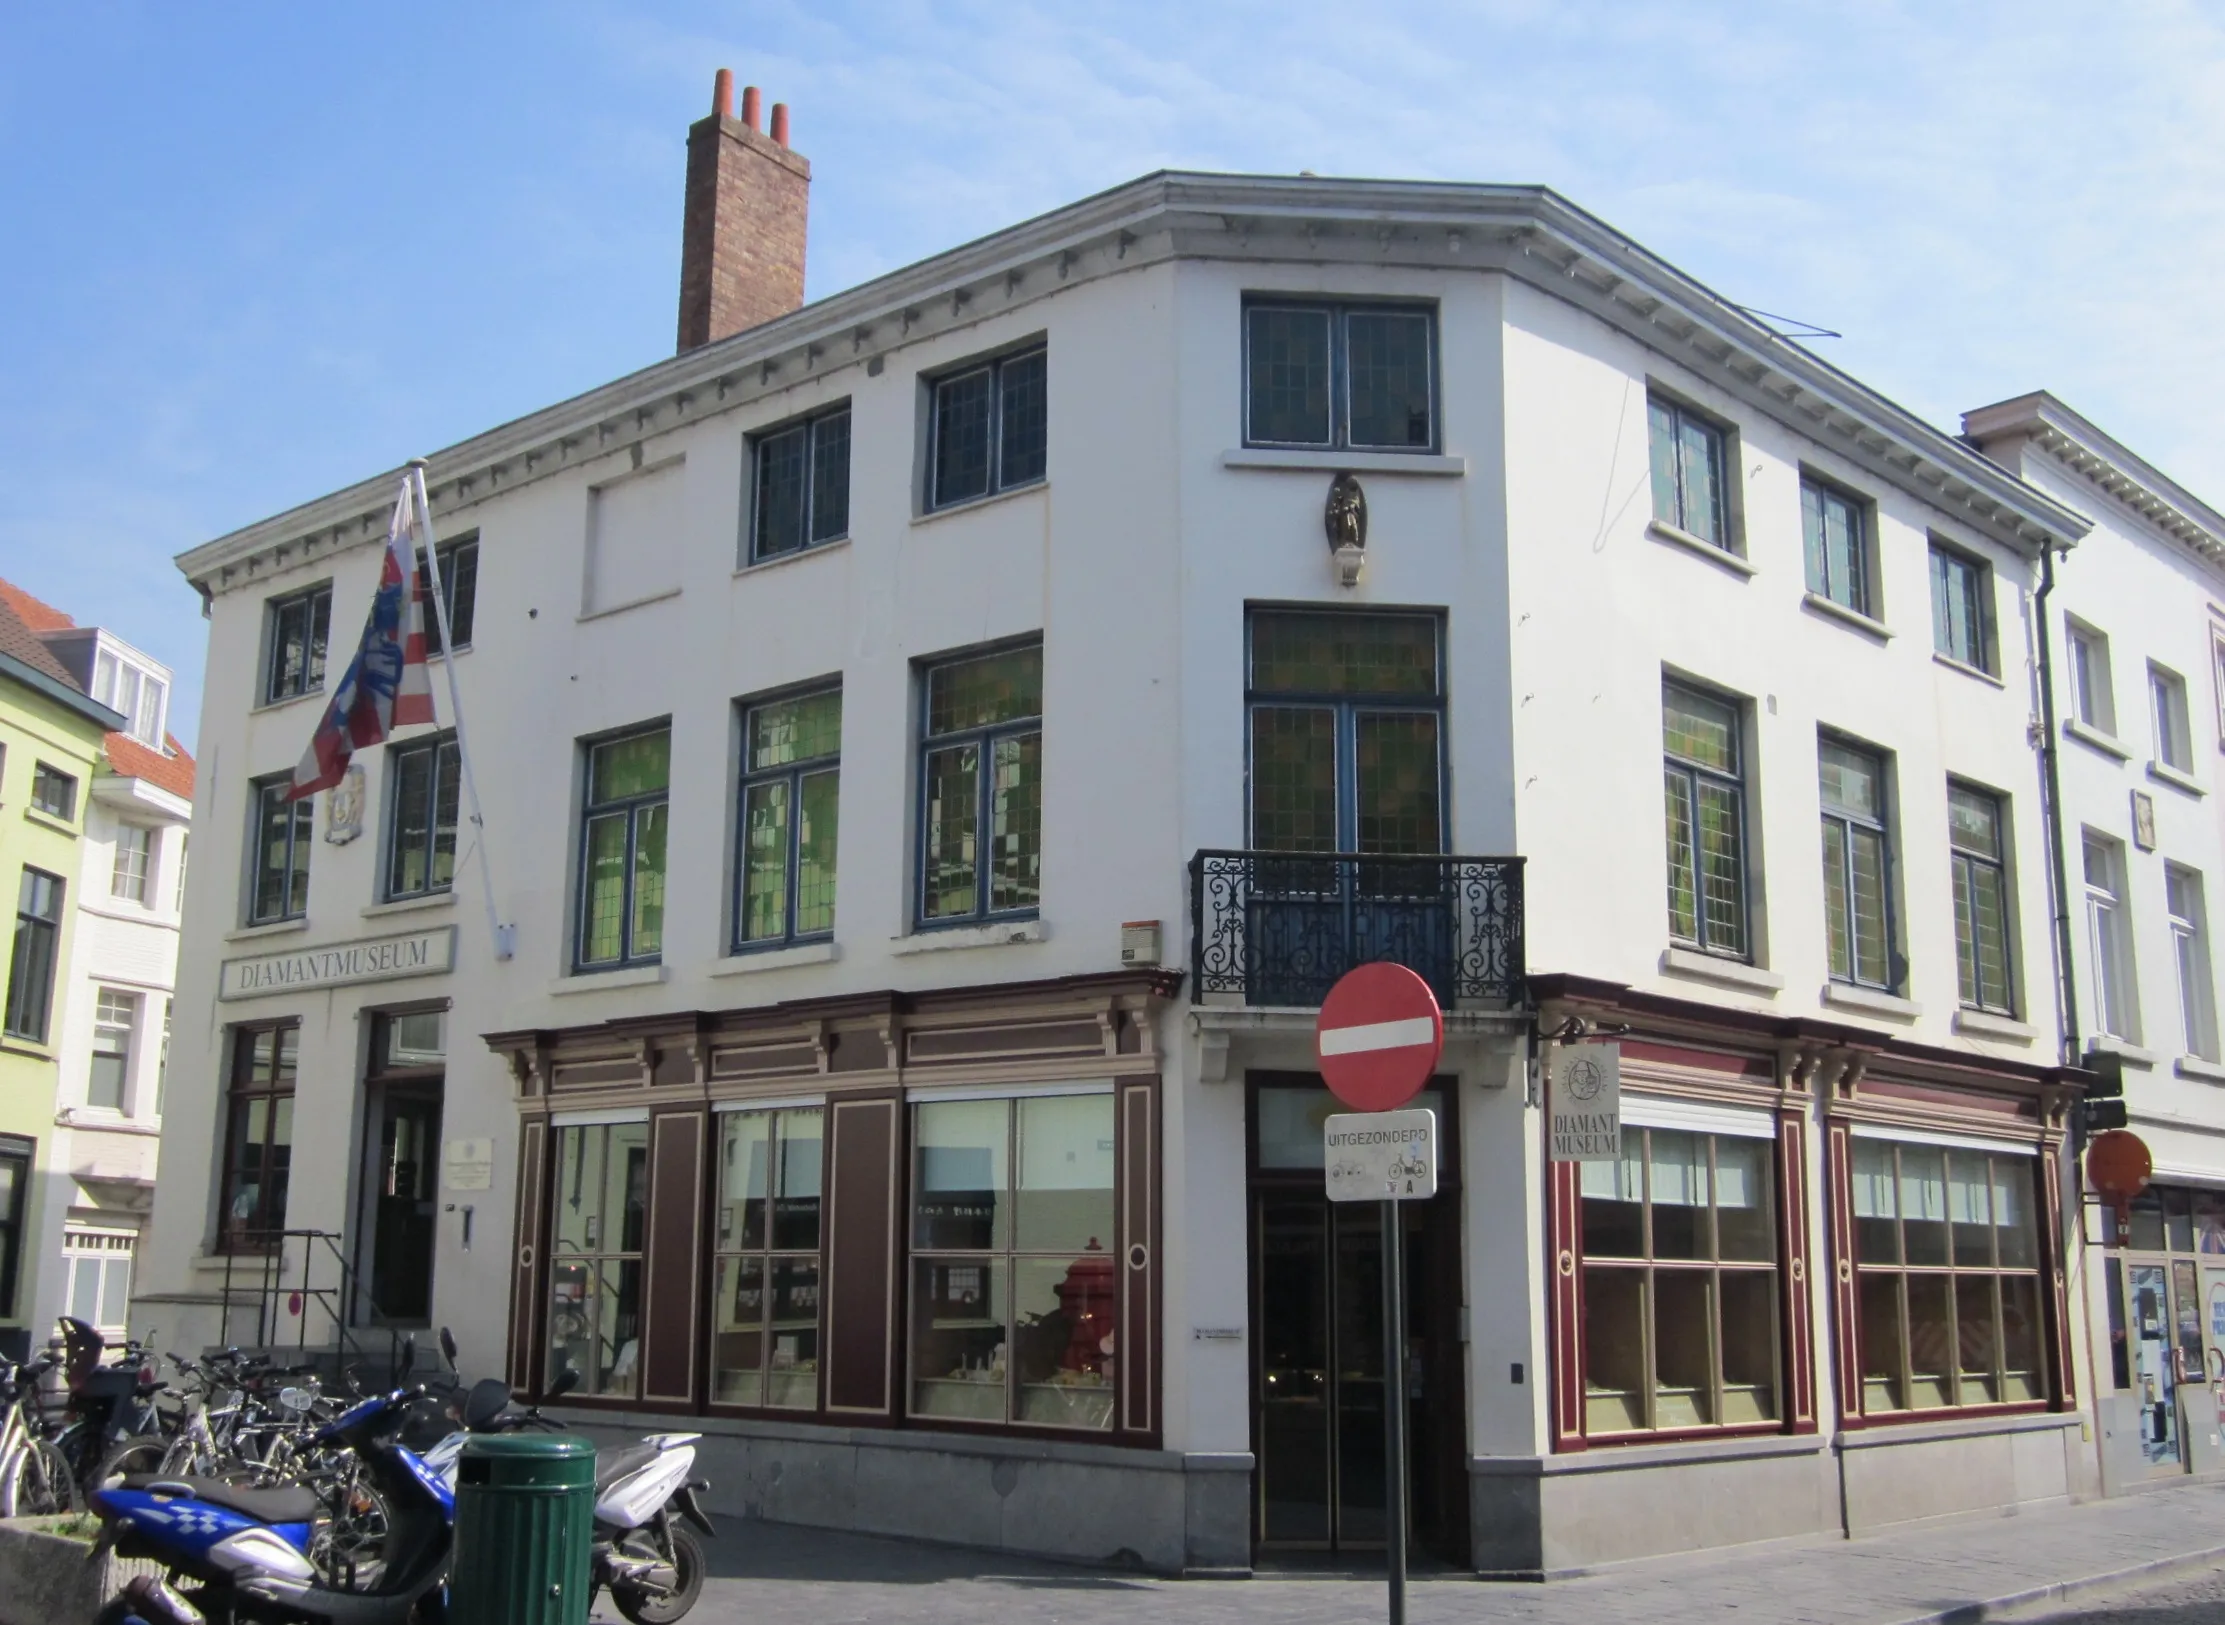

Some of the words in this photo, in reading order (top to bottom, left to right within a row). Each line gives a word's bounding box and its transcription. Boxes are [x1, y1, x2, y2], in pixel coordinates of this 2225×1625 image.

[240, 939, 429, 989] DIAMANTMUSEUM
[1555, 1113, 1616, 1134] DIAMANT
[1555, 1134, 1616, 1155] MUSEUM
[1405, 1180, 1414, 1194] A
